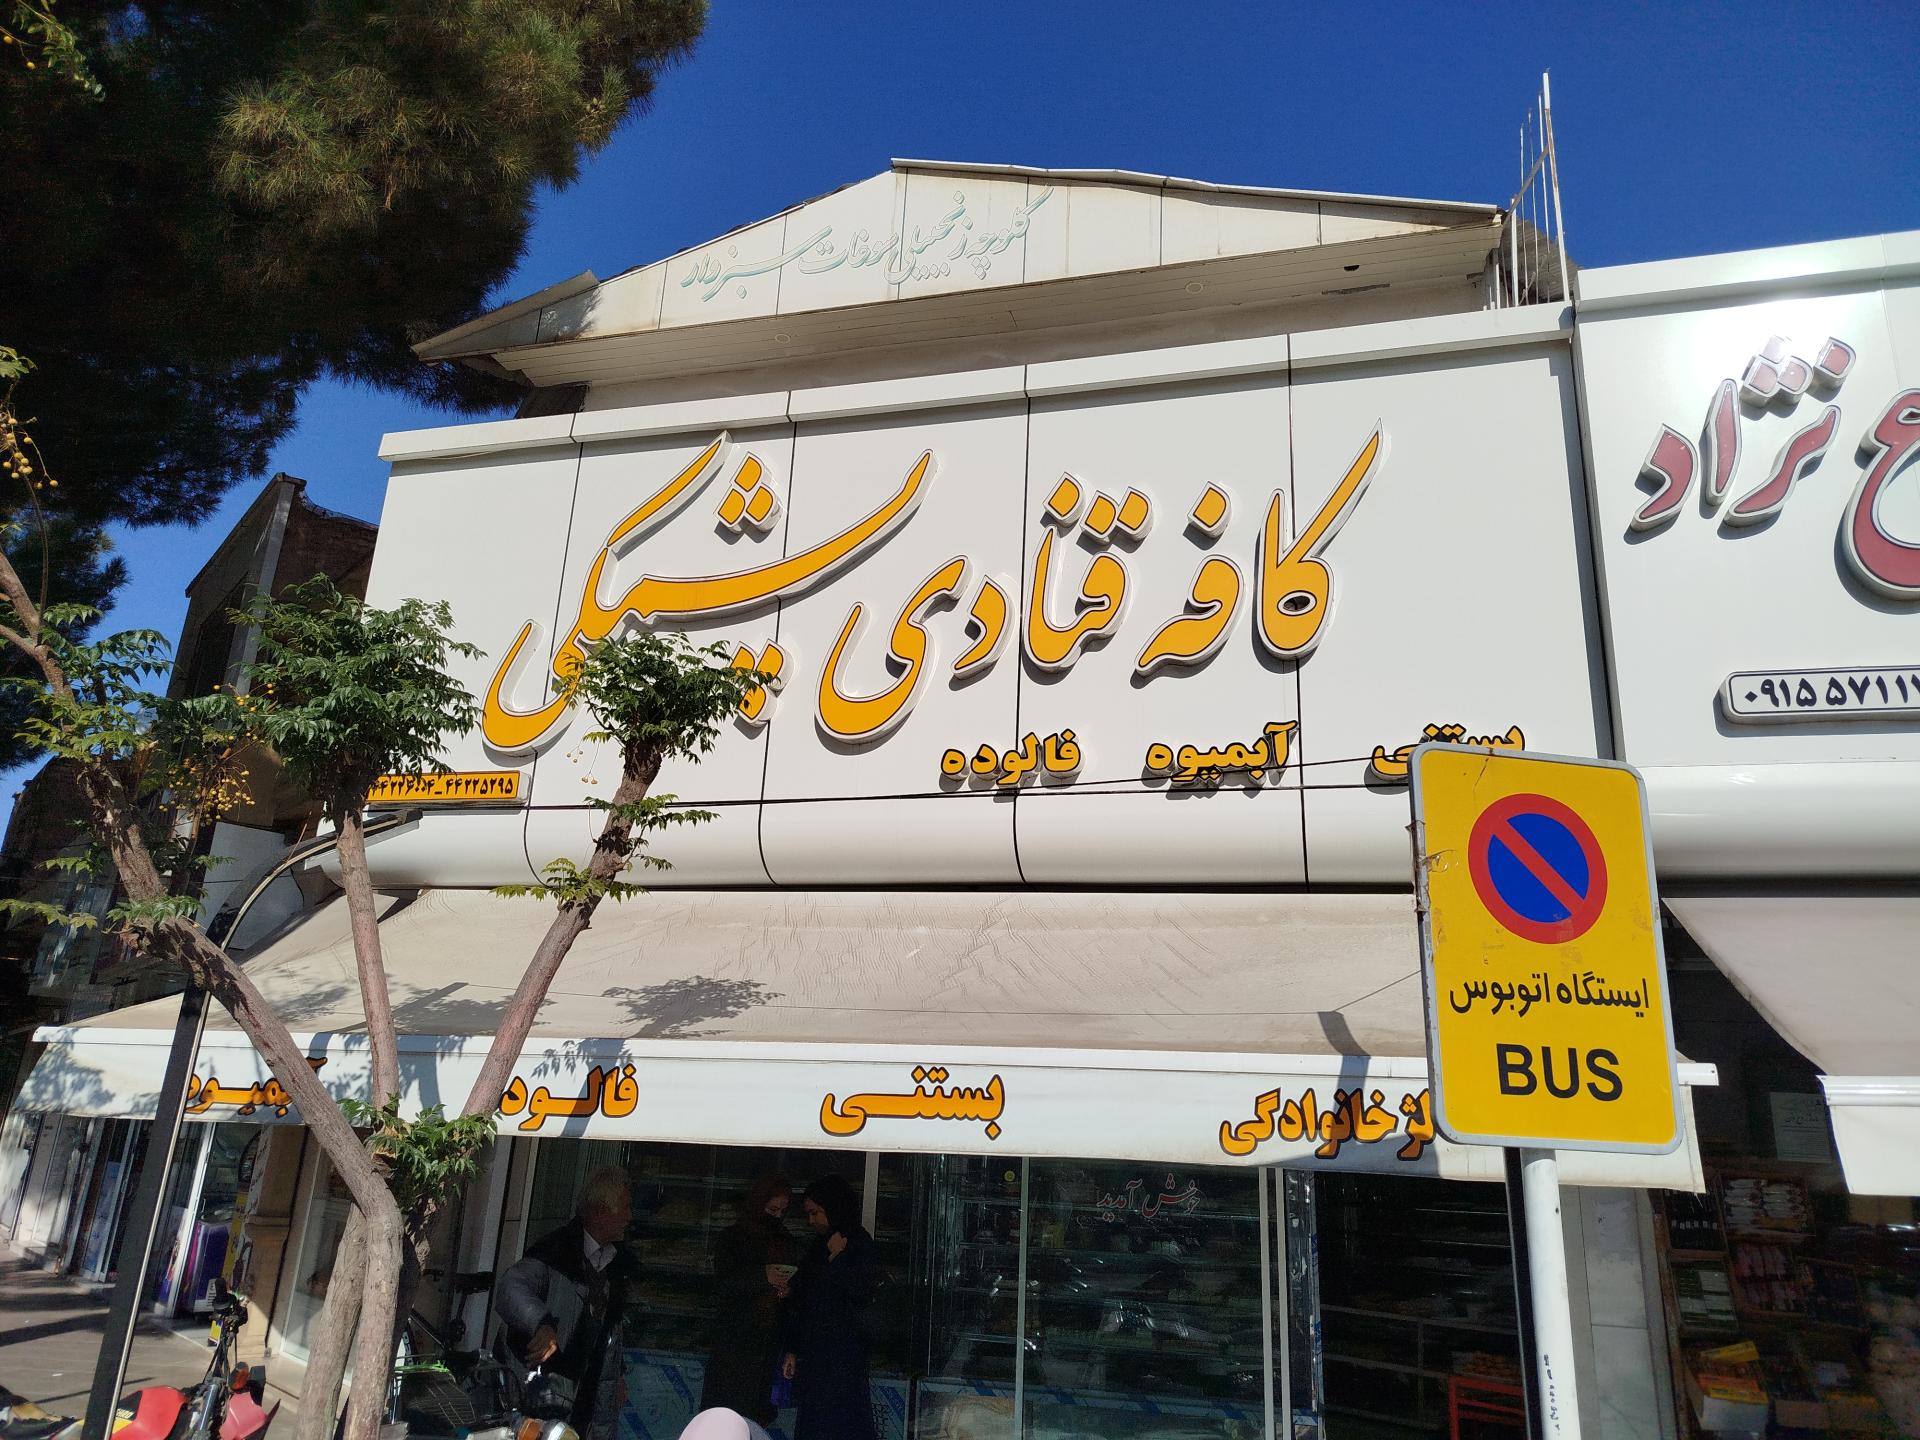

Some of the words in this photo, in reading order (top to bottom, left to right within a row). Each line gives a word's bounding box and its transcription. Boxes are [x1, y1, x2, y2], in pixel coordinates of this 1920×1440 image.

[680, 225, 832, 302] سبزوار
[798, 228, 899, 274] سوغات
[1633, 335, 1856, 526] نژاد
[1136, 420, 1383, 673] کافه
[817, 473, 1153, 741] قنادی
[940, 728, 1081, 785] فالوده
[1145, 720, 1298, 782] آبمیوه
[1450, 972, 1551, 1017] اتوبوس
[1557, 970, 1650, 1018] ایستگاه
[499, 1063, 639, 1131] فالود
[820, 1065, 1006, 1140] بستنی
[1496, 1043, 1624, 1102] BUS
[1219, 1087, 1399, 1158] خانوادگی
